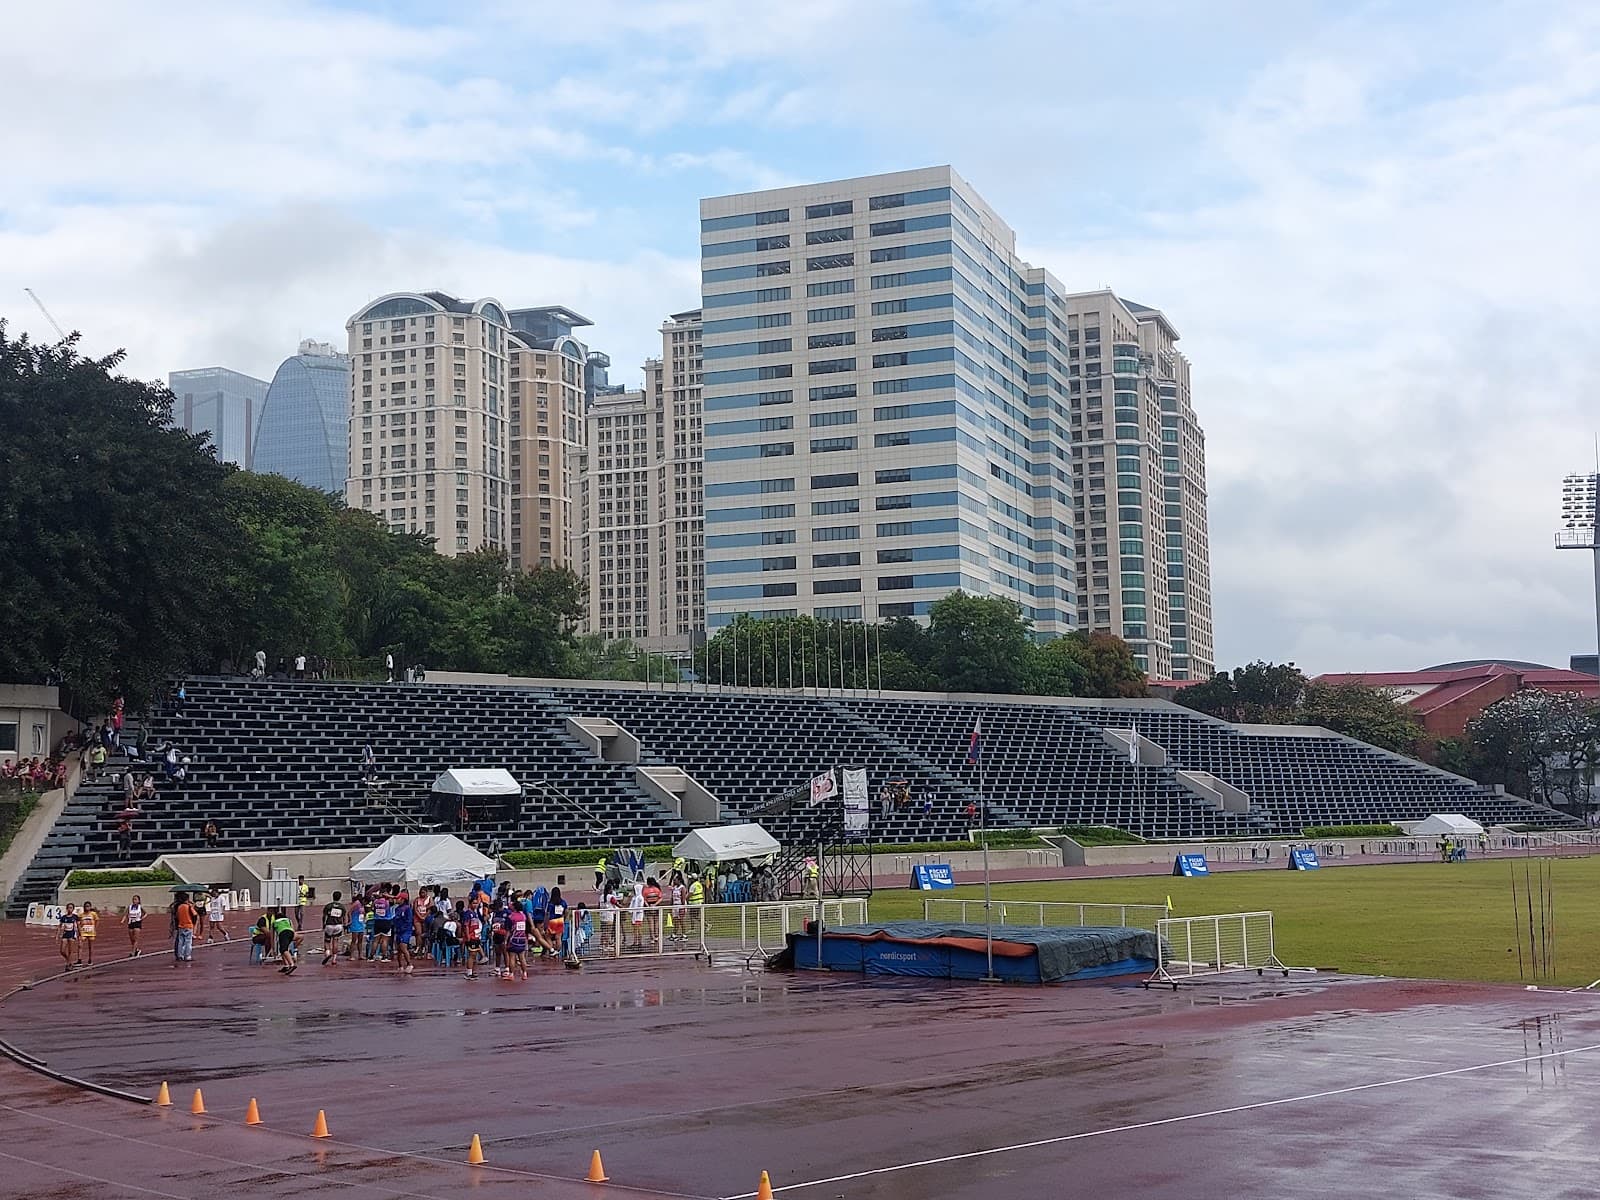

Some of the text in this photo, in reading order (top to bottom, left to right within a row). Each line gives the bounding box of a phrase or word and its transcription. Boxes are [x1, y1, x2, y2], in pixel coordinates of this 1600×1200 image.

[30, 907, 36, 918] 6
[46, 908, 53, 919] 4
[55, 907, 62, 920] 3
[880, 951, 917, 962] nordicsport
